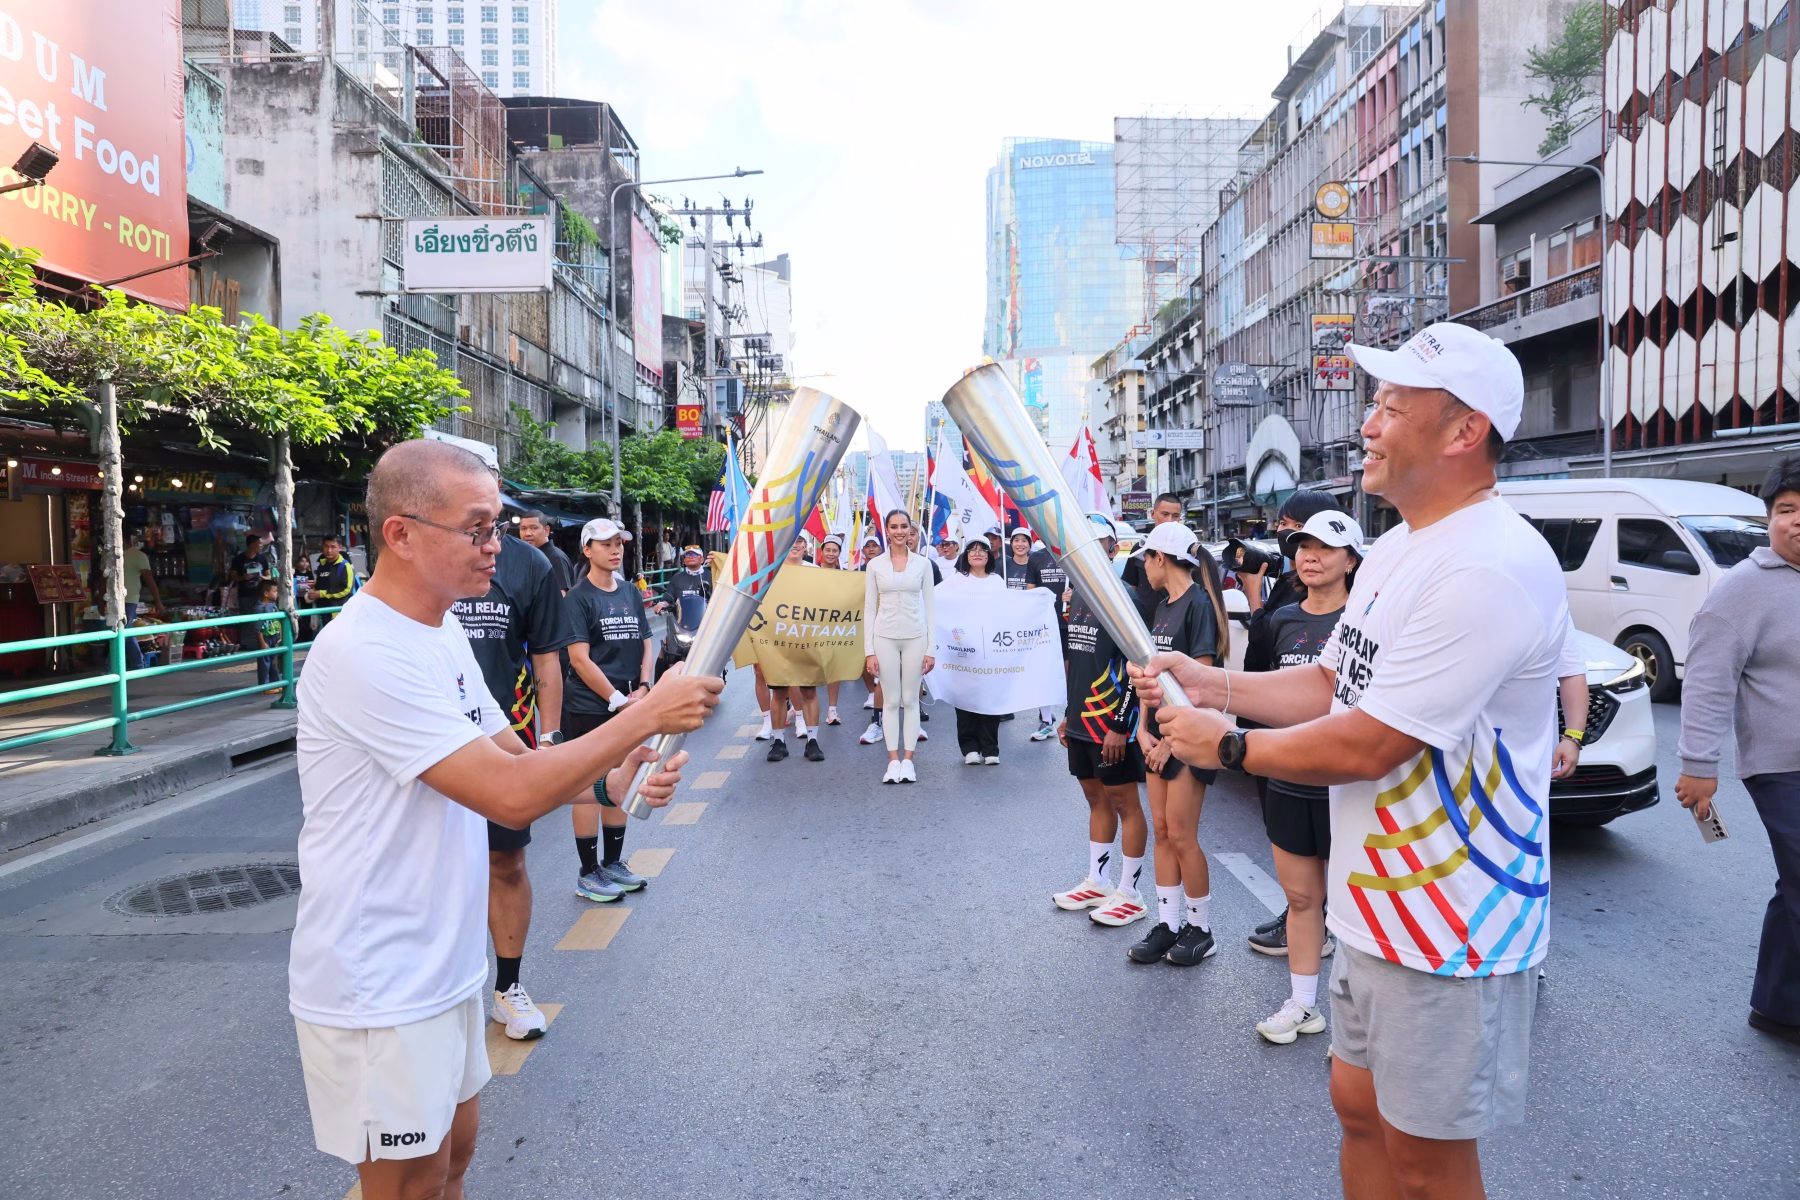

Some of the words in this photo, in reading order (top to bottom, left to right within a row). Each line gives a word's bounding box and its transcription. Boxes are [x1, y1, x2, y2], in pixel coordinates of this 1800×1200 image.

[74, 116, 160, 197] Food
[1020, 152, 1095, 169] NOVOTEL
[119, 215, 170, 261] ROTI
[813, 425, 840, 444] THAILAND
[65, 473, 89, 483] Street
[1122, 501, 1152, 512] Massage
[451, 601, 473, 614] RCH
[475, 601, 511, 616] RELAY
[775, 603, 862, 623] CENTRAL
[599, 616, 624, 627] TORCH
[603, 632, 630, 641] THAILAND
[775, 621, 857, 638] PATTANA
[773, 640, 811, 650] BETTER
[814, 640, 855, 648] FUTURES
[992, 631, 1014, 647] 45
[1280, 653, 1310, 665] TORCH
[942, 663, 971, 673] OFFICIAL
[972, 666, 993, 675] GOLD
[994, 664, 1025, 675] SPONSOR
